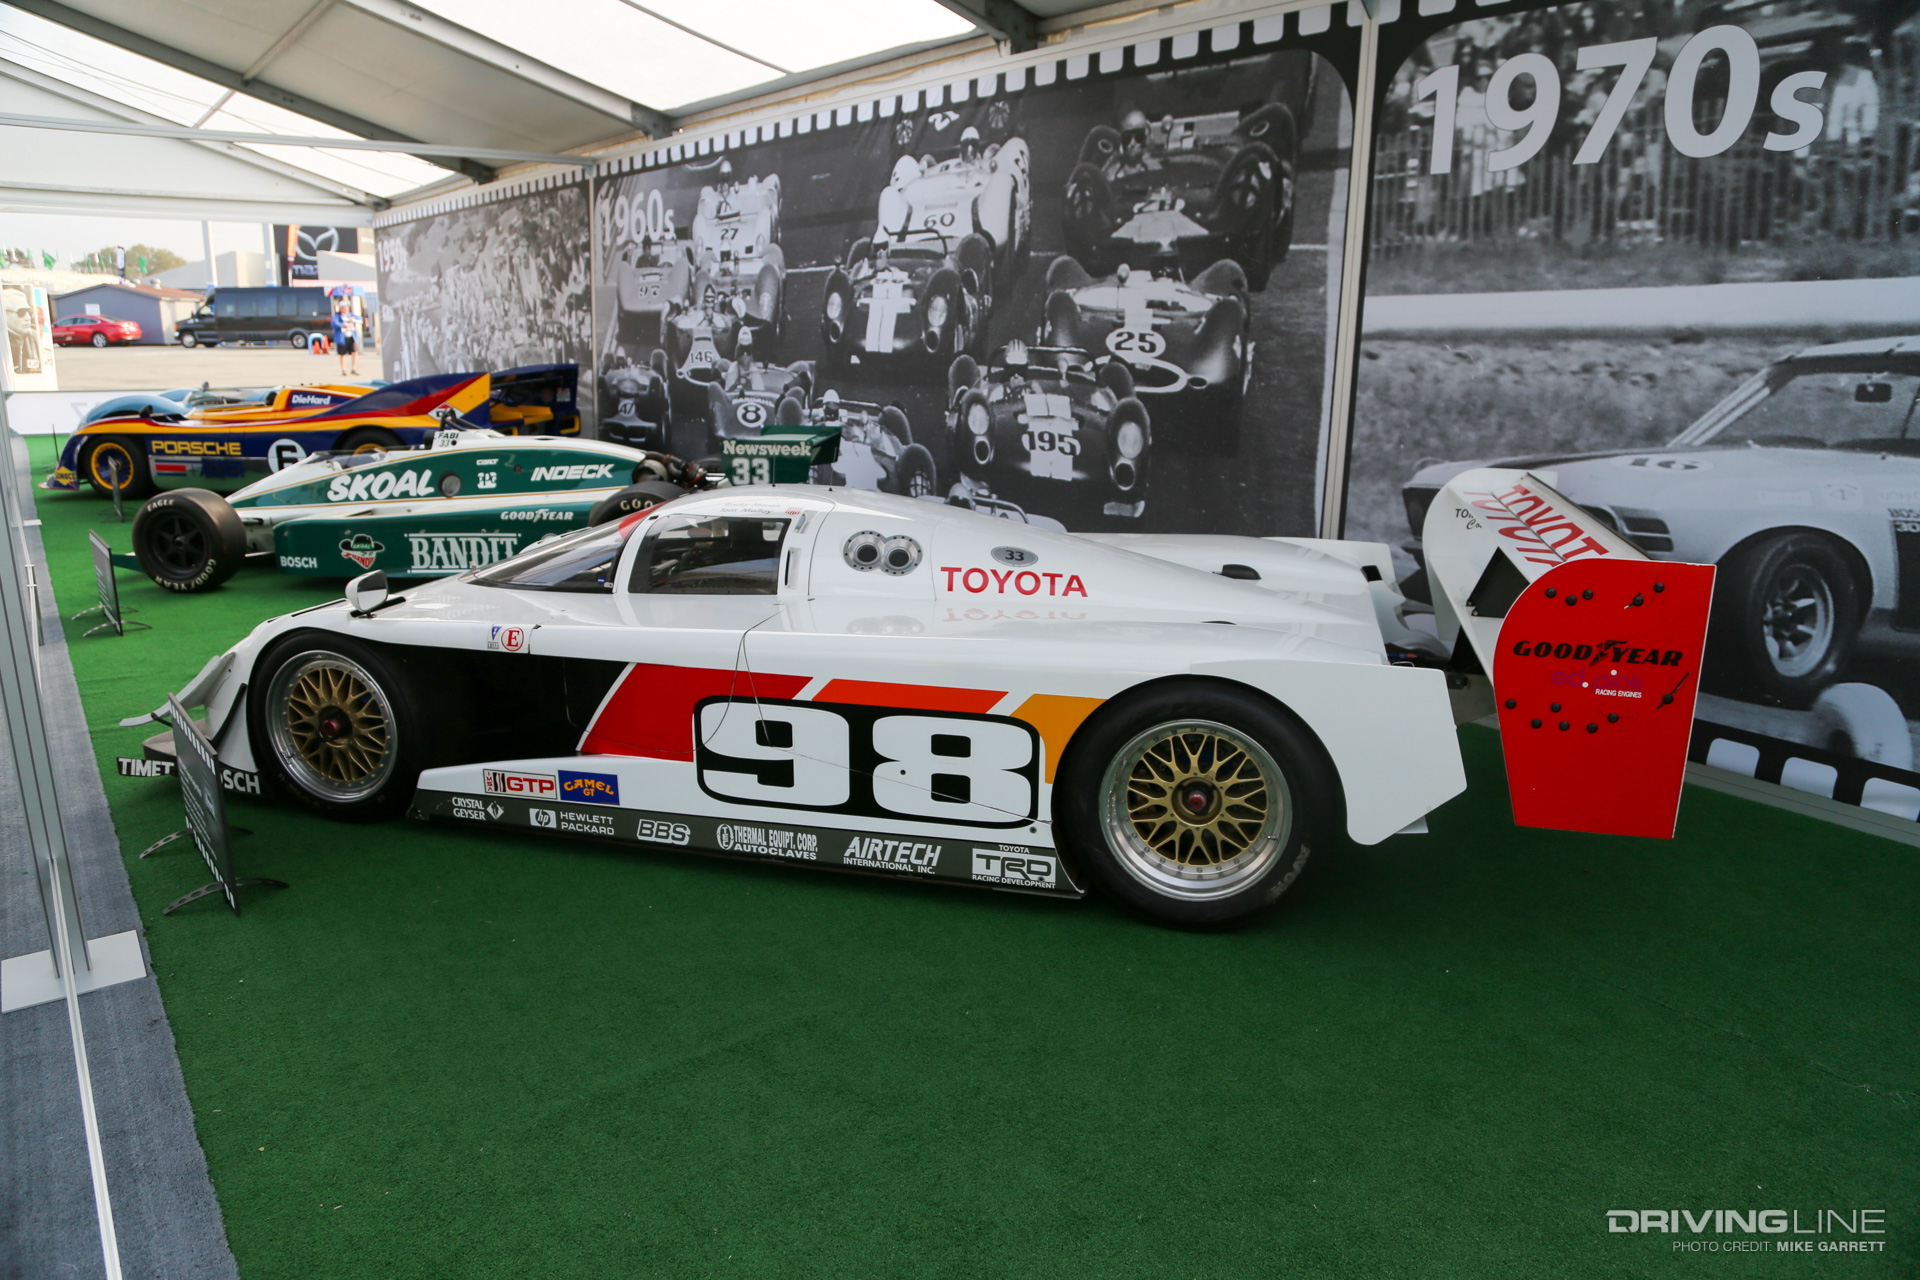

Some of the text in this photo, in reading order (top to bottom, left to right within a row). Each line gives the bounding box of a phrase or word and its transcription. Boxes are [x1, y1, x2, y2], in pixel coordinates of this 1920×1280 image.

[1417, 24, 1828, 175] 1970s
[602, 188, 676, 247] 1960s
[924, 212, 956, 229] 60
[720, 227, 739, 241] 27
[377, 237, 408, 273] 1950s
[639, 284, 661, 297] 97
[1114, 331, 1157, 354] 25
[690, 350, 713, 364] 146
[291, 394, 332, 406] DieHard
[741, 403, 762, 426] 8
[437, 431, 460, 441] FABI
[1023, 430, 1078, 457] 195
[151, 440, 242, 456] PORSCHE
[722, 439, 812, 457] Newsweek
[530, 464, 615, 482] INDECK
[731, 457, 771, 486] 33
[326, 469, 435, 502] SKOAL
[146, 498, 175, 513] EAGLE
[500, 508, 574, 521] GOODYEAR
[279, 555, 318, 569] BOSCH
[409, 536, 518, 570] BANDIT
[1004, 549, 1025, 562] 33
[940, 566, 1089, 598] TOYOTA
[506, 629, 520, 648] E
[1512, 640, 1684, 667] GOODYEAR
[1551, 668, 1645, 694] ed pink
[1595, 688, 1643, 699] RACING ENGINES
[700, 701, 1033, 824] 98
[506, 776, 555, 794] GTP
[562, 778, 615, 796] CAMEL
[582, 787, 596, 797] GT
[451, 796, 485, 811] CRYSTAL
[453, 807, 487, 821] GEYSER
[536, 812, 550, 827] hp
[560, 811, 614, 825] HEWLETT
[560, 821, 615, 835] PACKARD
[636, 819, 691, 846] BBS
[733, 825, 819, 853] THERMAL EQUIPT. CORP.
[733, 842, 818, 861] AUTOCLAVES
[844, 836, 942, 867] AIRTECH
[998, 844, 1030, 855] TOYOTA
[843, 856, 936, 875] INTERNATIONAL INC.
[975, 853, 1052, 881] TRD
[971, 873, 1057, 890] RACING DEVELOPMENT
